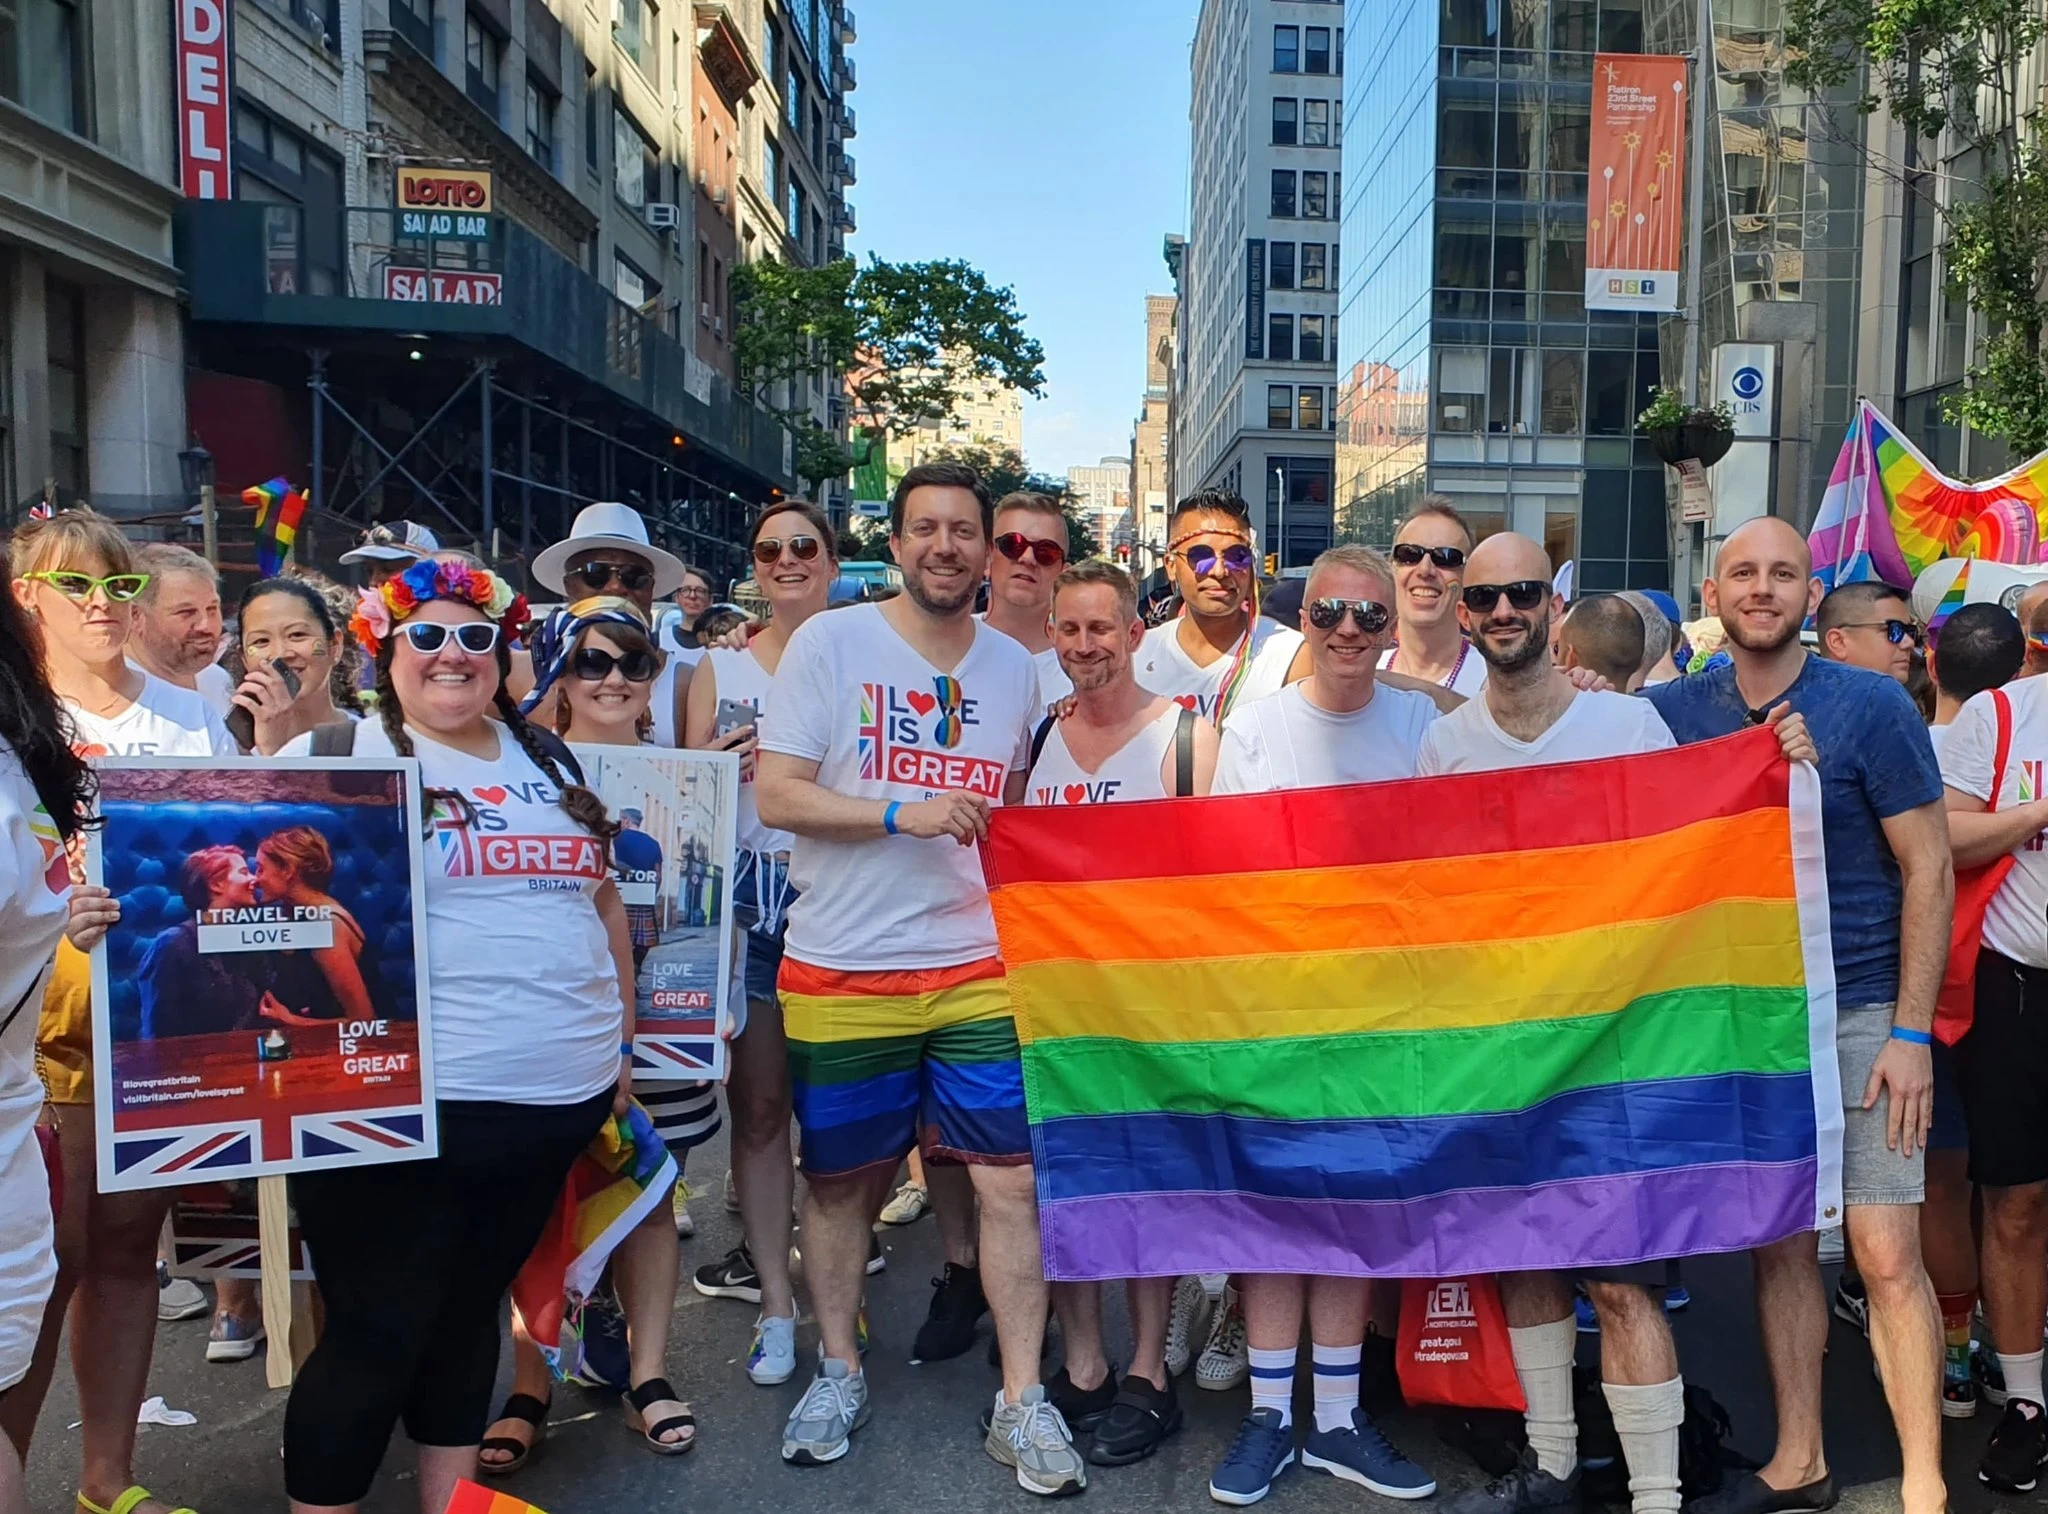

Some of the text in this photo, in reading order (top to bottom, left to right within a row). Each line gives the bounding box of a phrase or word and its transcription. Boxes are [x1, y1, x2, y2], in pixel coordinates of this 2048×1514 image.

[1607, 85, 1641, 94] Flatiron
[183, 0, 222, 199] DELI
[1607, 94, 1656, 103] 23rd Street
[1607, 103, 1656, 112] Partnership
[403, 177, 486, 208] LOTTO
[457, 216, 487, 236] BAR
[1732, 402, 1760, 414] CBS
[889, 715, 920, 744] IS
[893, 752, 1001, 793] GREAT
[528, 879, 581, 893] BRITAIN
[196, 905, 332, 924] I TRAVEL FOR
[241, 929, 291, 944] LOVE
[654, 964, 692, 976] LOVE
[654, 978, 666, 989] IS
[654, 993, 708, 1006] GREAT
[339, 1020, 388, 1038] LOVE
[340, 1039, 357, 1055] IS
[344, 1055, 408, 1074] GREAT
